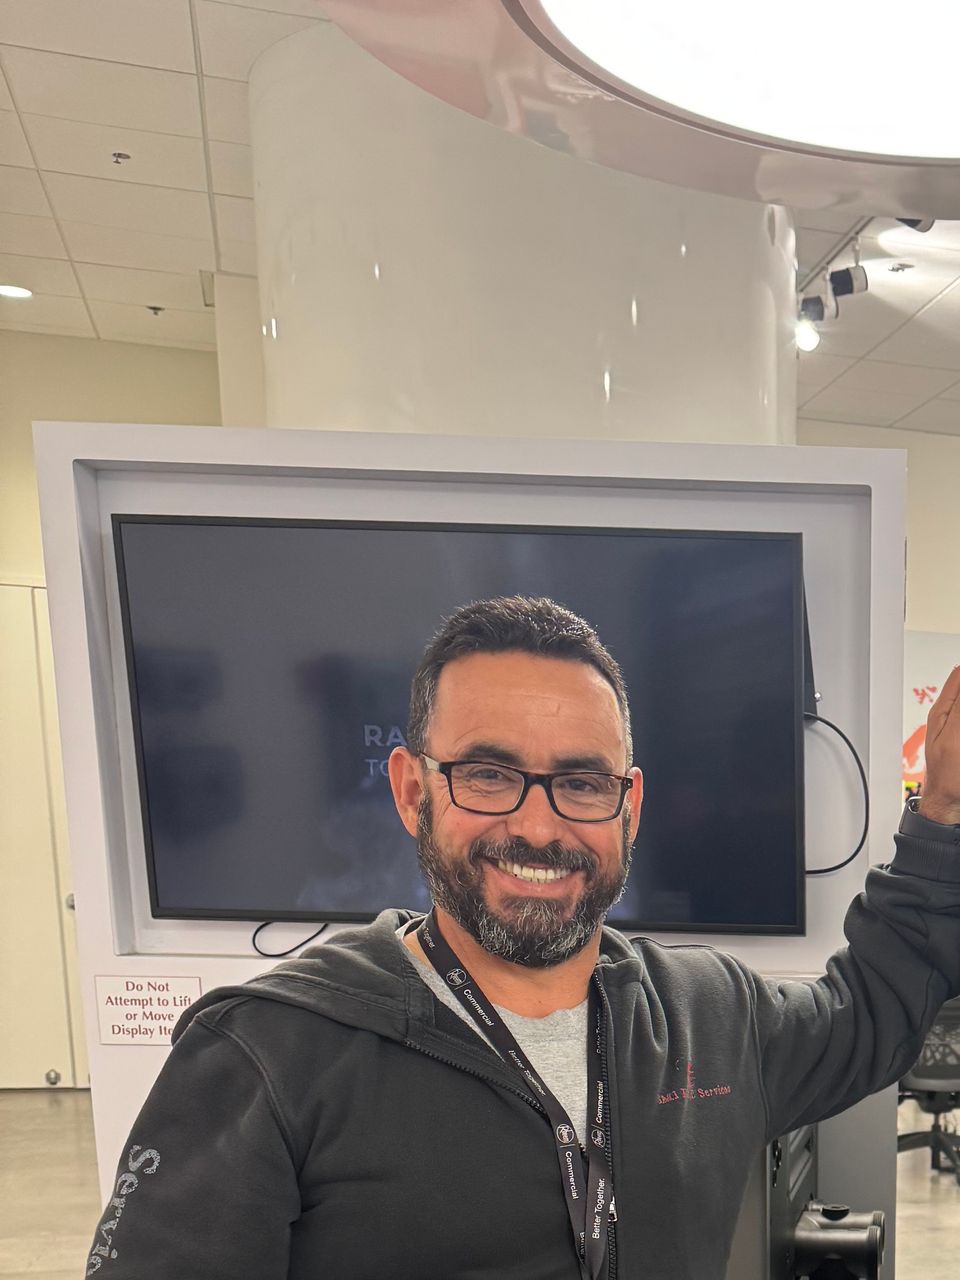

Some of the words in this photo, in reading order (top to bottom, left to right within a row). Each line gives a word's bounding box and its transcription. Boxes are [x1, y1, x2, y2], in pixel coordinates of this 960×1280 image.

[125, 981, 143, 991] Do
[147, 981, 170, 992] Not
[105, 995, 153, 1009] Attempt
[157, 996, 169, 1007] to
[463, 989, 495, 1027] Commercial
[125, 1012, 138, 1020] or
[142, 1011, 174, 1020] Move
[111, 1024, 155, 1038] Display
[595, 1081, 604, 1123] Commercial
[565, 1151, 579, 1200] Commercial
[594, 1178, 606, 1213] Together.
[592, 1214, 601, 1239] Better
